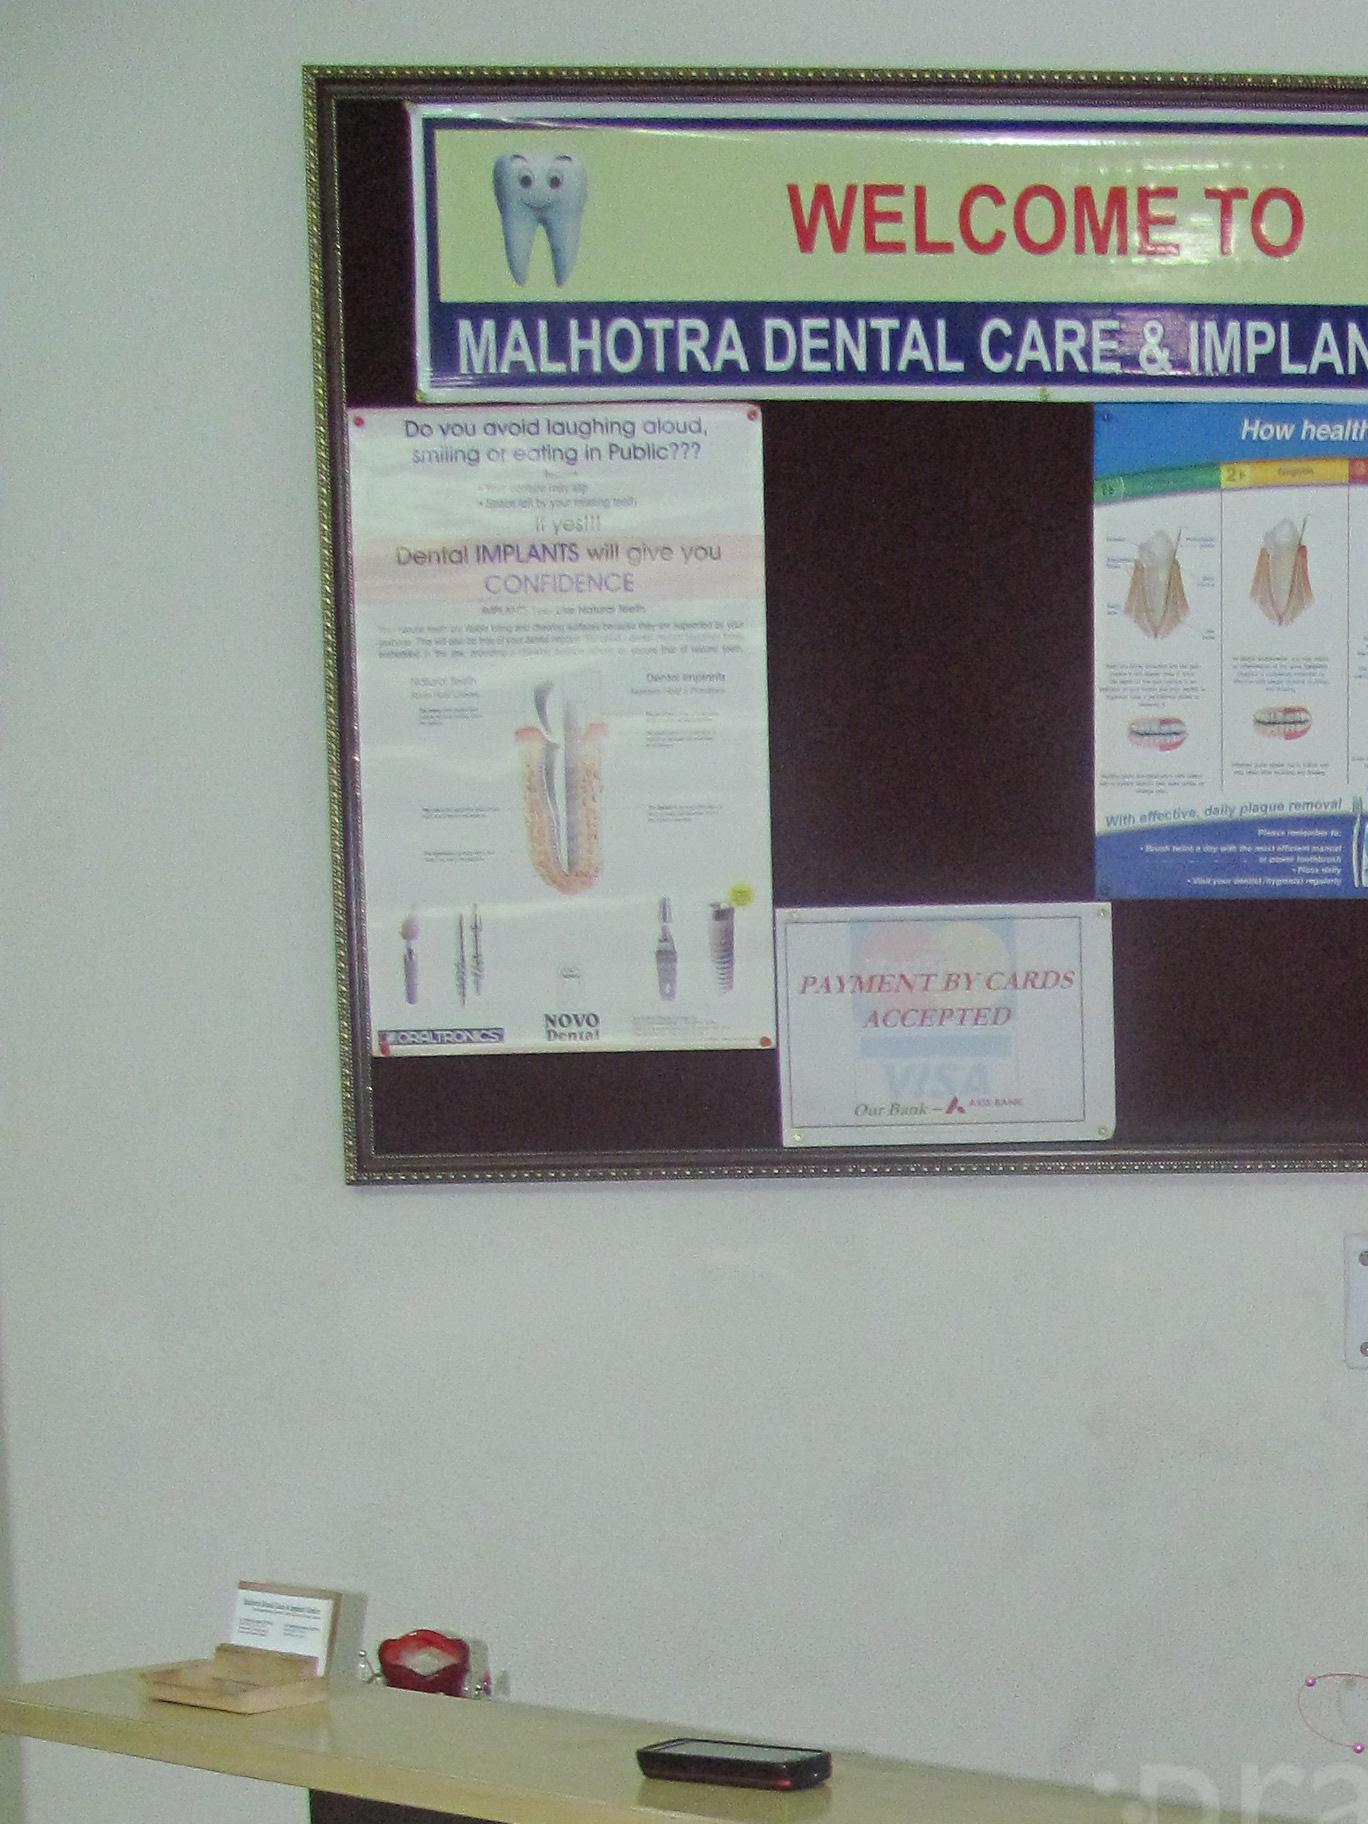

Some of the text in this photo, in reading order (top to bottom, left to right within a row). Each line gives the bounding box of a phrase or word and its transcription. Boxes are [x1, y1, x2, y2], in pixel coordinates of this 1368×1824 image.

[787, 182, 1305, 258] WELCOME TO
[456, 318, 749, 375] MALHOTRA
[763, 318, 965, 374] DENTAL
[979, 318, 1121, 374] CARE
[1137, 320, 1174, 375] &
[405, 417, 708, 441] Do you avoid laughing aloud,
[1241, 418, 1295, 442] How
[412, 441, 702, 466] smiling or eating in Public???
[396, 543, 722, 566] Dental IMPLANTS will give you
[484, 572, 635, 595] CONFIDENCE
[1105, 813, 1136, 828] With
[1138, 808, 1200, 825] effective,
[1204, 803, 1236, 818] daily
[1238, 801, 1285, 818] plaque
[1288, 798, 1342, 812] removal
[800, 969, 1078, 996] PAYMENT BY CARDS
[544, 1013, 600, 1028] NOVO
[862, 1006, 1013, 1029] ACCEPTED
[546, 1028, 600, 1042] Dental
[854, 1101, 929, 1118] Our Bank
